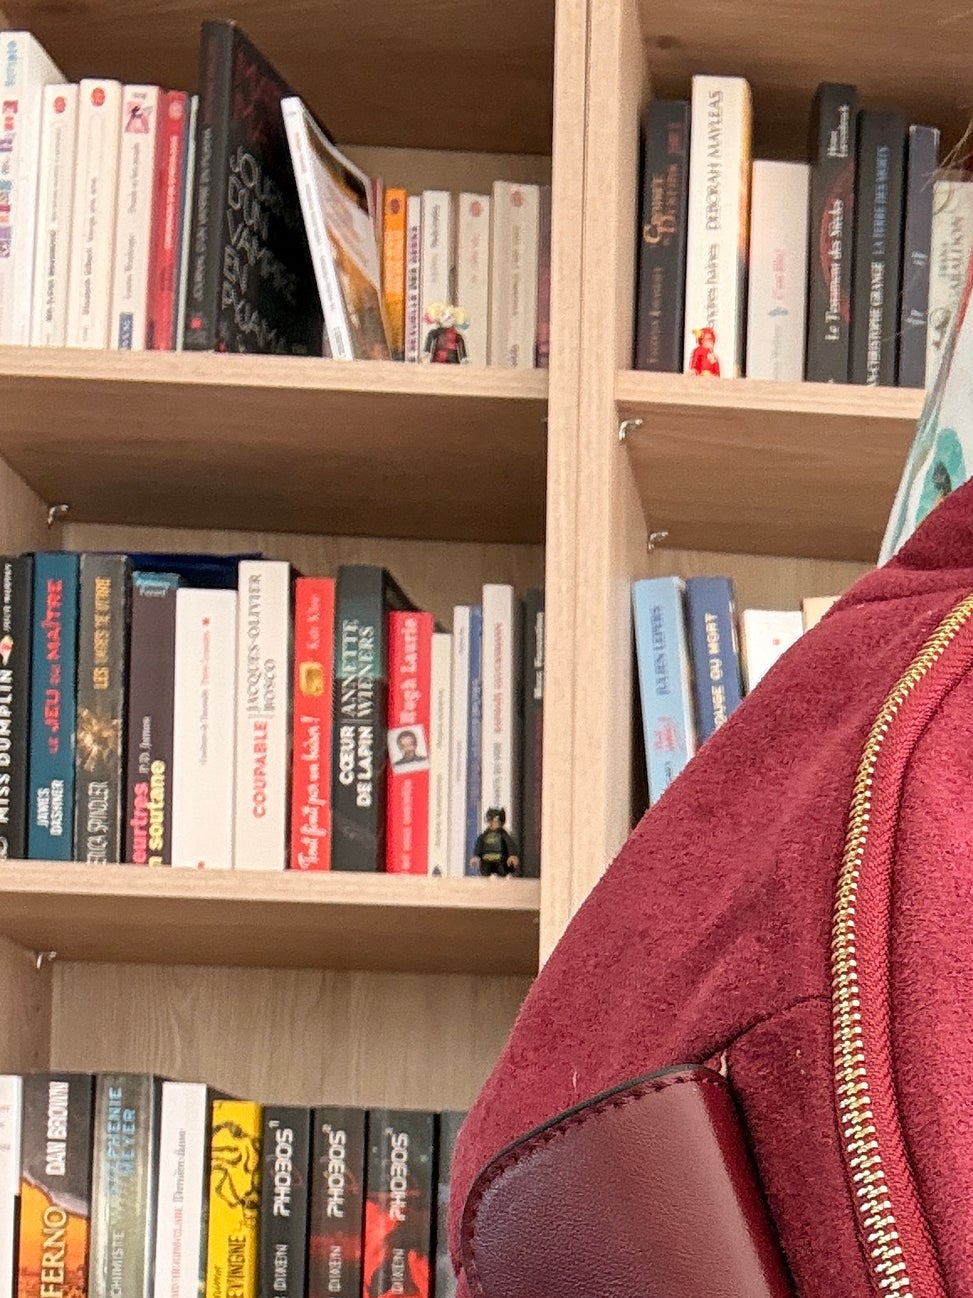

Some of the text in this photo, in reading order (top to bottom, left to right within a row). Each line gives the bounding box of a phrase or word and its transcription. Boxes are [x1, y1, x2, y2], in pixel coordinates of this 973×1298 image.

[705, 164, 722, 231] DEBORAH
[828, 240, 842, 260] des
[824, 326, 841, 341] Le
[41, 579, 63, 660] MAÎTRE
[247, 573, 264, 712] JACQUES-OLIVIER
[263, 658, 277, 712] BOSCO
[340, 618, 358, 717] ANNETTE
[357, 624, 375, 717] WIENERS
[399, 618, 421, 725] Hugh Laurie
[704, 613, 729, 727] OUGE OU MORT
[45, 689, 61, 732] JEU
[48, 737, 59, 754] LE
[253, 722, 268, 818] COUPABLE
[339, 726, 356, 785] CŒUR
[357, 726, 374, 807] DE LAPIN
[0, 774, 11, 823] MISS
[37, 788, 50, 827] JAMES
[51, 779, 64, 836] DASHNER
[87, 781, 109, 832] SPINDLER
[131, 782, 148, 865] eurtres
[147, 760, 165, 850] soutane
[45, 1081, 70, 1175] DAN BROWN
[120, 1108, 136, 1176] MEYER
[273, 1128, 294, 1218] PHOBOS
[327, 1130, 348, 1219] PHOBOS
[389, 1132, 410, 1222] PHOBOS
[110, 1231, 125, 1298] CHIMISTE
[272, 1244, 288, 1291] DIXEN
[328, 1245, 343, 1293] DIXEN
[389, 1248, 406, 1294] DIXEN
